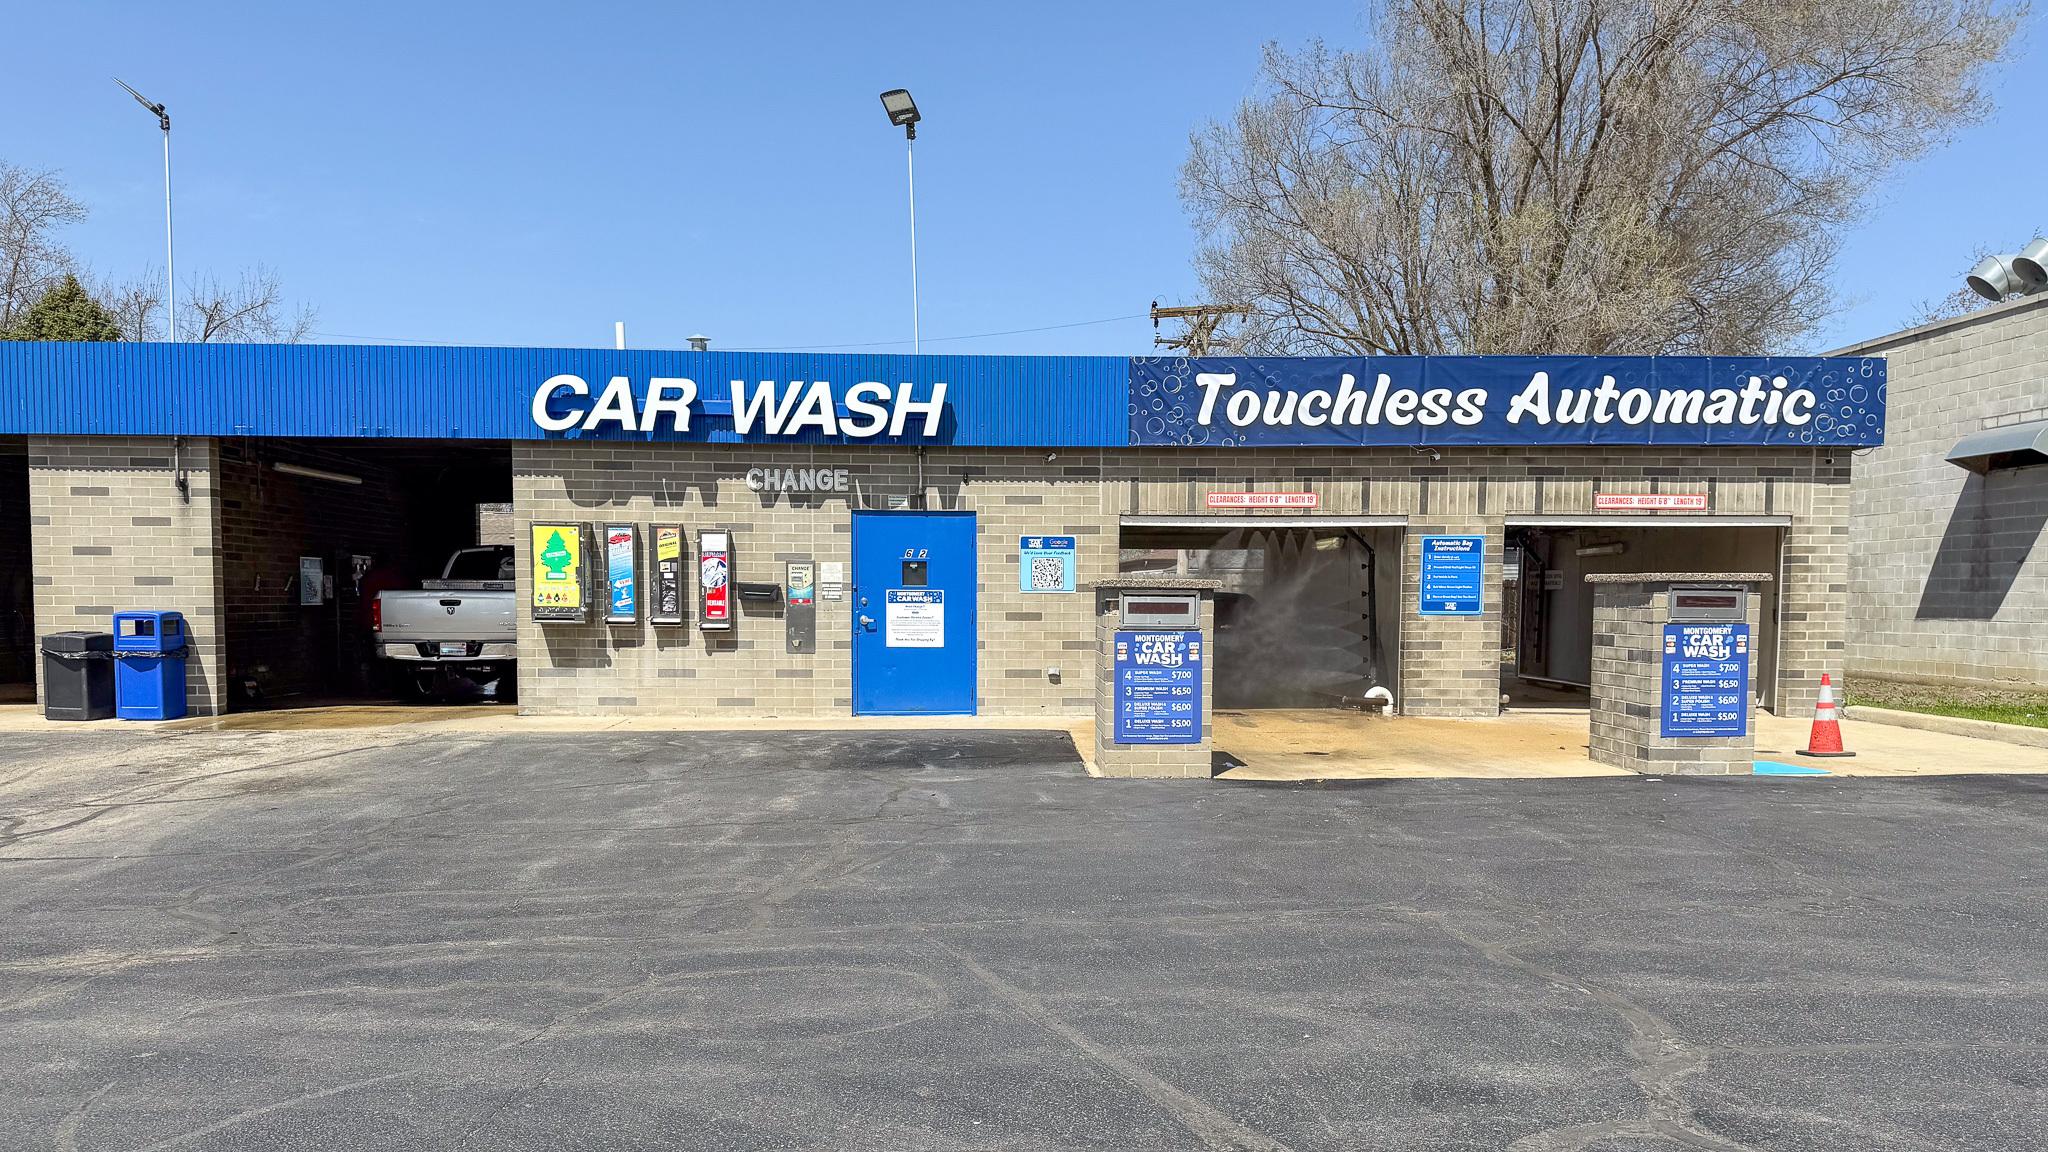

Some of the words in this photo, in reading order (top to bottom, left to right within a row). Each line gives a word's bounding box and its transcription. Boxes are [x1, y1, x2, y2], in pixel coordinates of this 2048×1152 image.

[1195, 373, 1488, 427] Touchless
[1506, 371, 1816, 425] Automatic
[531, 374, 697, 432] CAR
[730, 380, 948, 437] WASH
[746, 468, 849, 492] CHANGE
[1209, 496, 1246, 504] CLEARANCES:
[1248, 496, 1268, 504] HEIGHT
[1285, 496, 1306, 504] LENGTH
[1638, 497, 1657, 505] HEIGHT
[1674, 497, 1694, 505] LENGTH
[1134, 634, 1184, 642] MONTGOMERY
[1690, 634, 1723, 646] CAR
[1142, 642, 1176, 654] CAR
[1683, 646, 1731, 658] WASH
[1134, 653, 1184, 666] WASH
[1672, 664, 1680, 673] 4
[1720, 664, 1738, 672] $7.00
[1125, 671, 1132, 680] 4
[1172, 671, 1192, 680] $7.00
[1673, 680, 1679, 689] 3
[1719, 680, 1738, 688] $6.50
[1126, 687, 1132, 696] 3
[1172, 687, 1192, 695] $6.50
[1672, 696, 1679, 705] 2
[1718, 696, 1738, 705] $6.00
[1126, 703, 1132, 712] 2
[1172, 703, 1191, 711] $6.00
[1672, 713, 1678, 722] 1
[1126, 719, 1132, 728] 1
[1172, 719, 1191, 728] $5.00
